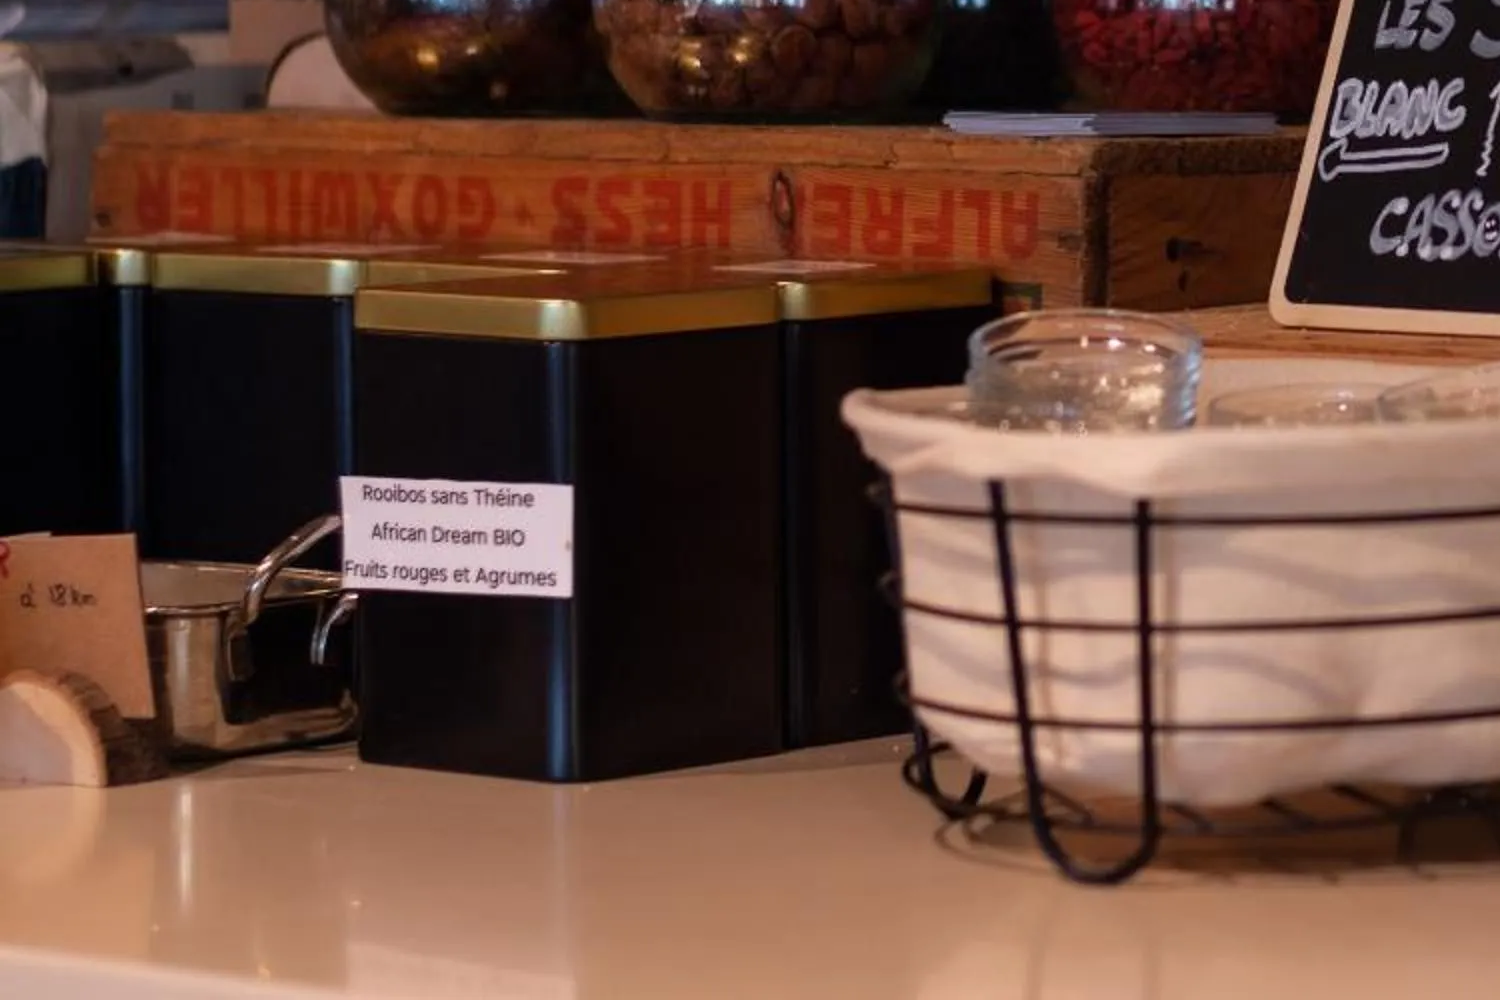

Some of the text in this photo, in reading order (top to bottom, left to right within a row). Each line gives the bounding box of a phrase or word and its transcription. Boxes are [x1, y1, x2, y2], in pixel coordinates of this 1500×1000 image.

[1330, 76, 1466, 140] BLANC
[548, 173, 732, 251] HESS
[362, 484, 536, 508] Rooibos sans Théine
[371, 521, 526, 547] African Dream BIO
[345, 559, 558, 589] Fruits rouges et Agrumes
